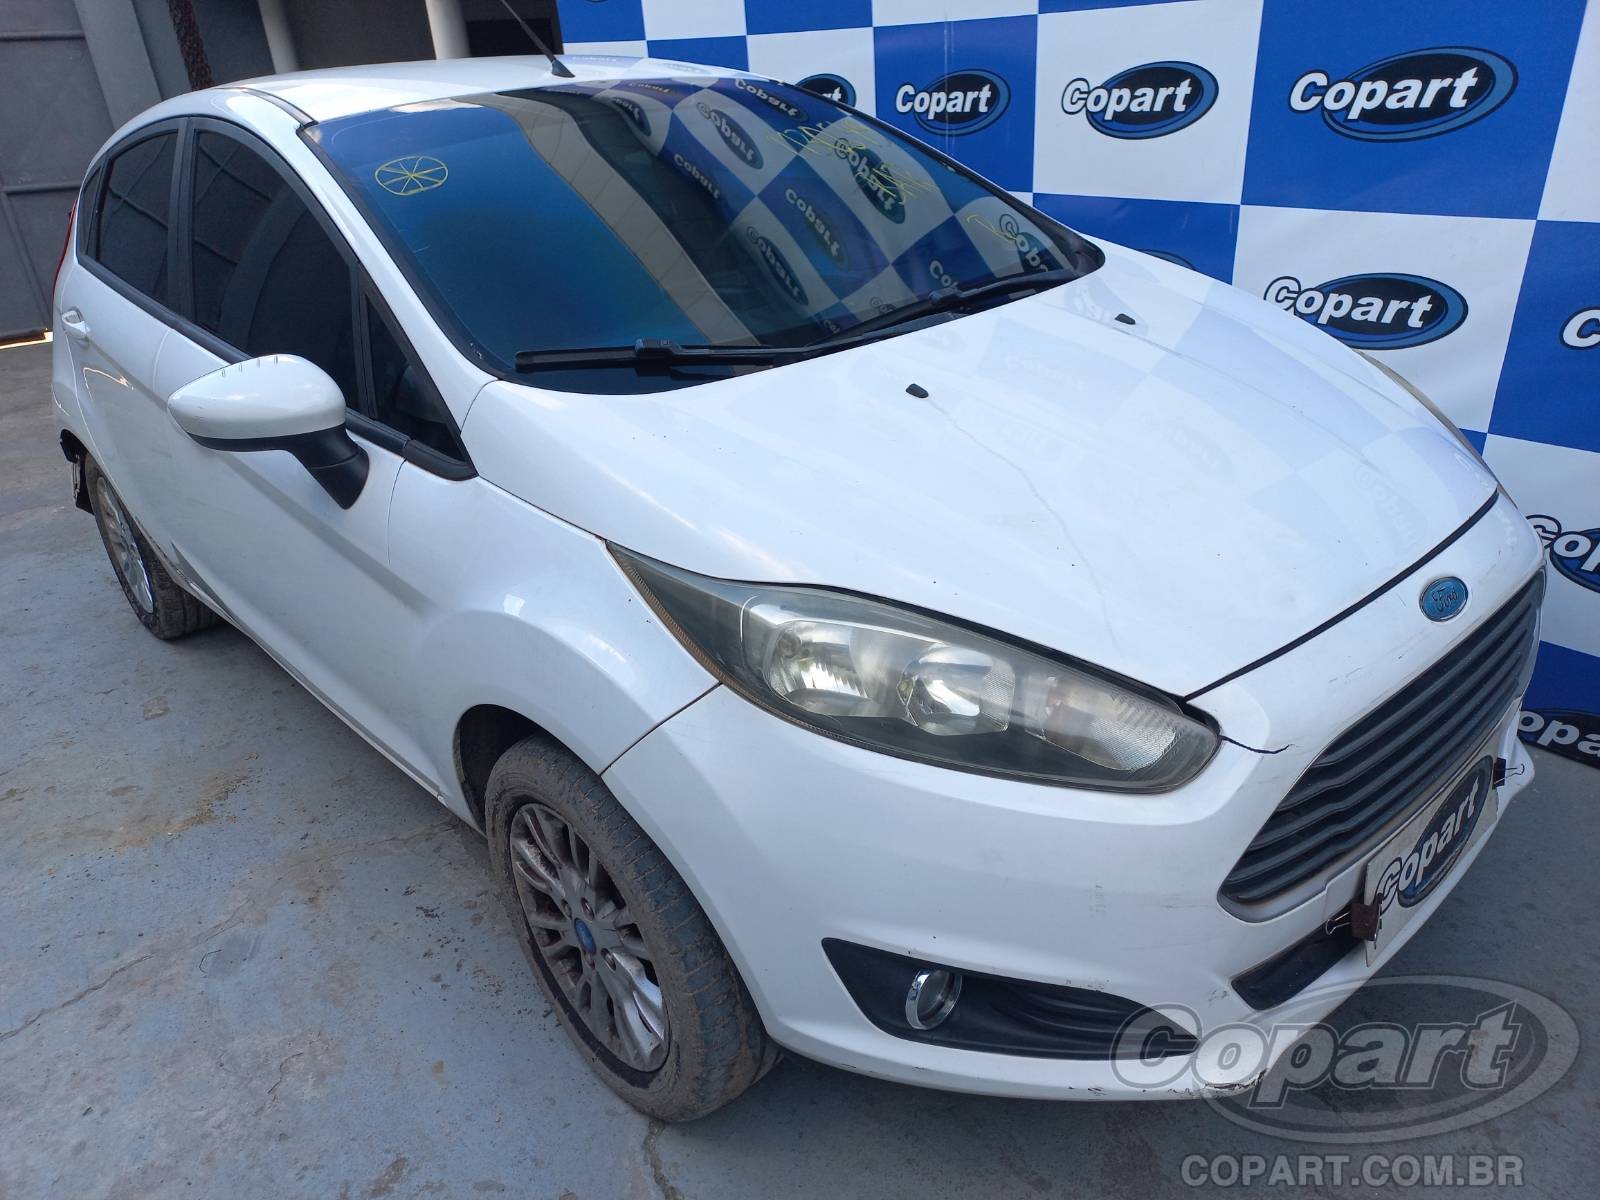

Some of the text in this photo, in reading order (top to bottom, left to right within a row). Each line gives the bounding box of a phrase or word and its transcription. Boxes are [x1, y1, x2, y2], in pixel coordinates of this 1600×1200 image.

[895, 83, 992, 120] Copart
[1061, 78, 1192, 121] Copart
[1289, 66, 1479, 120] Copart
[1264, 276, 1433, 329] Copart
[1517, 710, 1600, 757] opa
[1374, 776, 1479, 916] Copart
